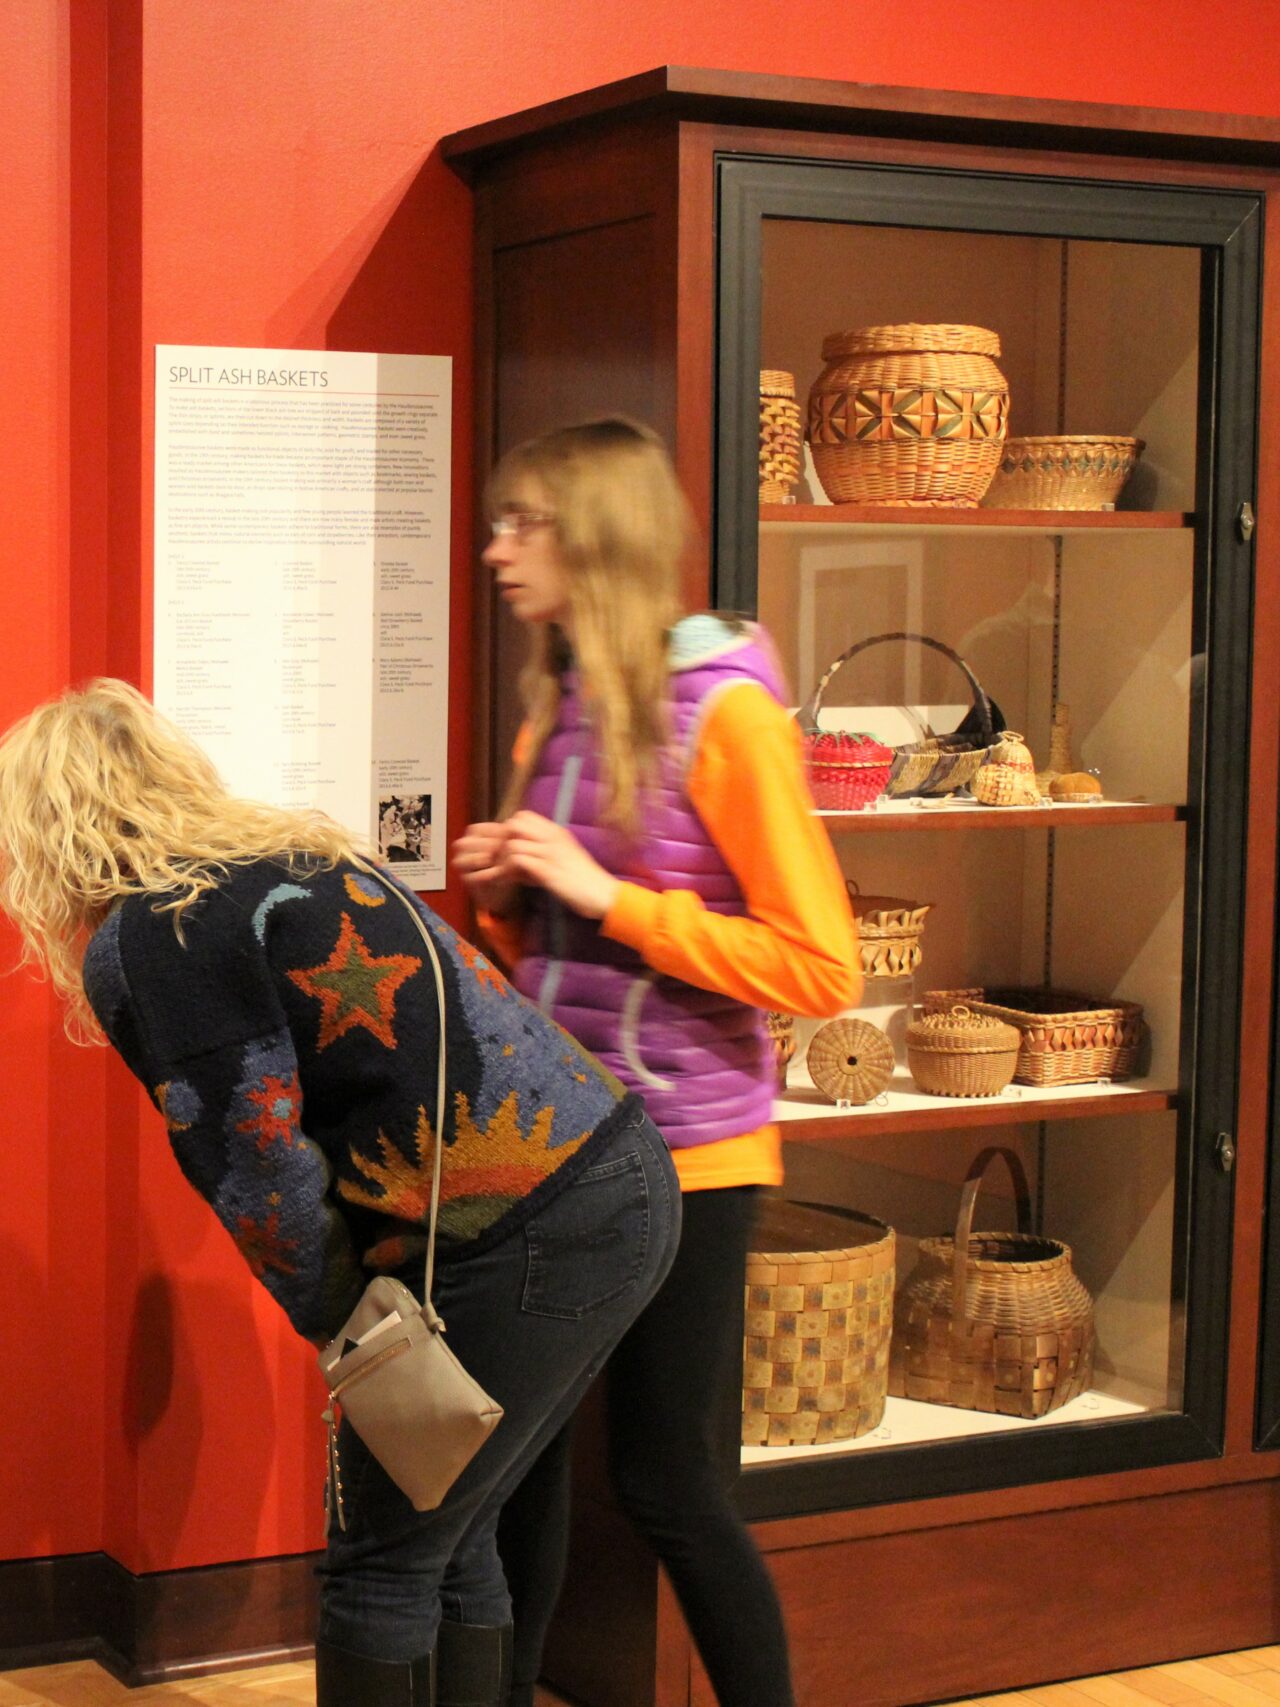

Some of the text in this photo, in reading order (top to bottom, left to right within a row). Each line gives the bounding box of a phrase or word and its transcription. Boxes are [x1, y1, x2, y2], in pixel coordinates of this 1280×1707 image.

[169, 366, 329, 387] SPLIT ASH BASKETS
